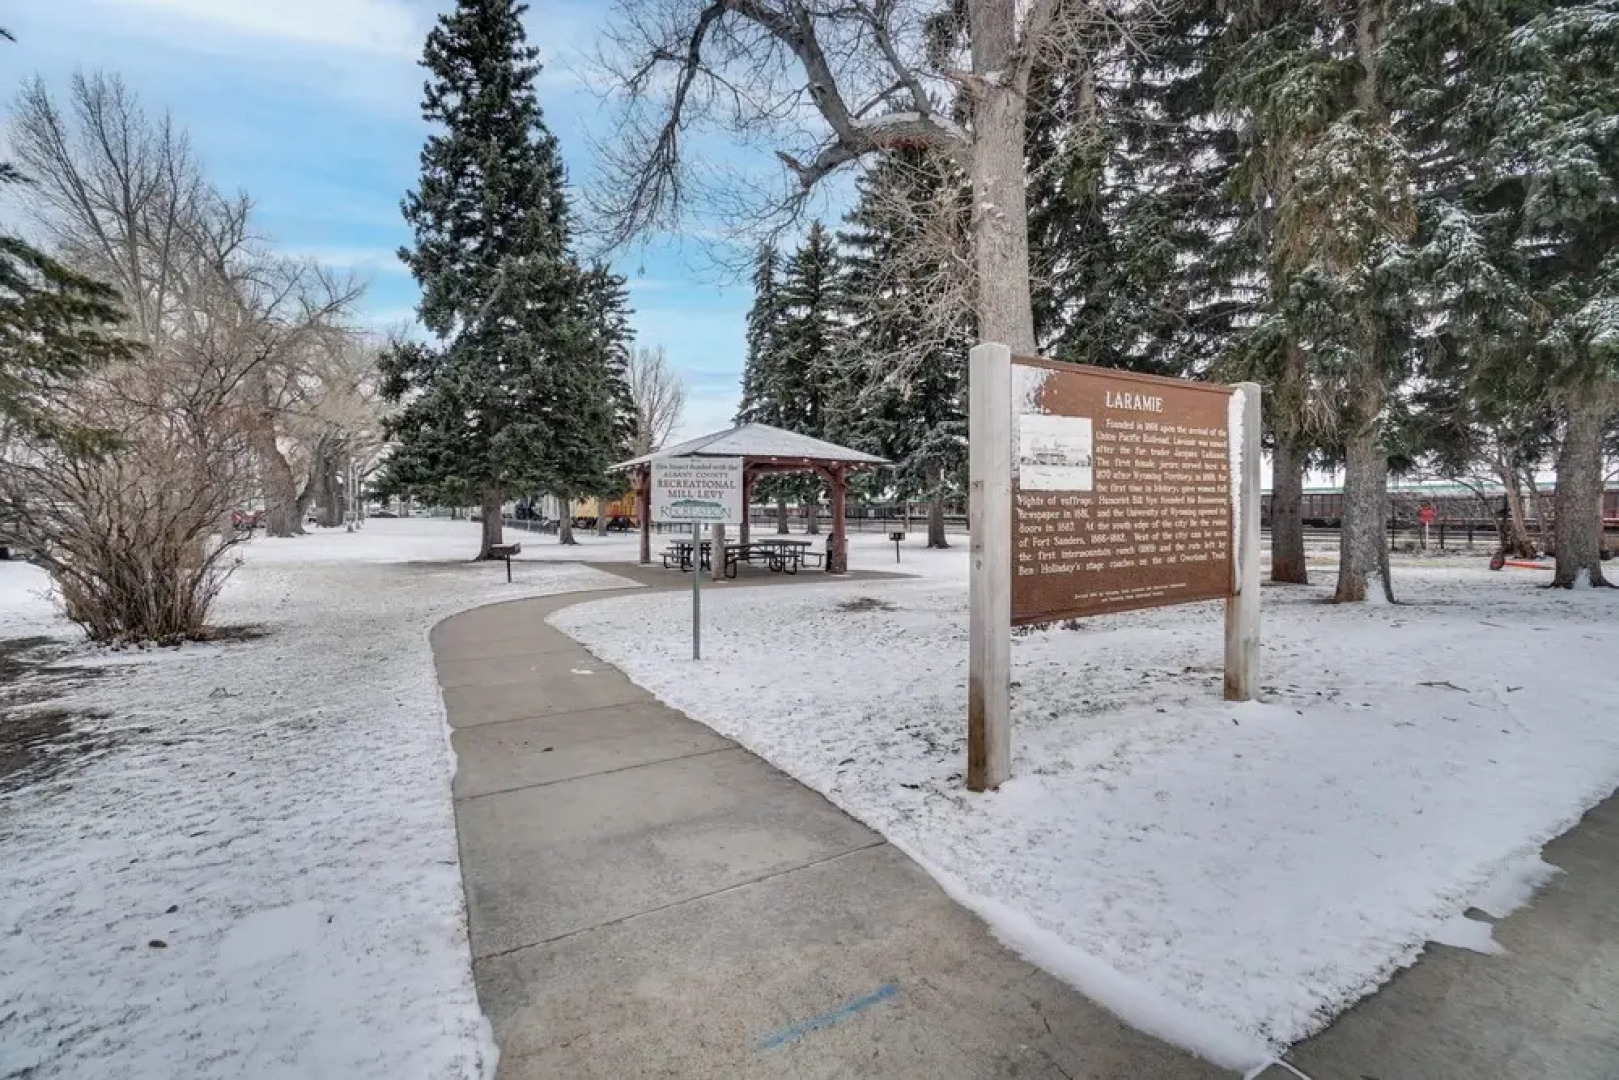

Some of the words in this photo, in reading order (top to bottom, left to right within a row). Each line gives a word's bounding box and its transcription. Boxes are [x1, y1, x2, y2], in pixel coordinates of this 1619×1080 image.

[1106, 391, 1164, 413] LARAMIE
[1106, 419, 1135, 429] Founded
[1136, 421, 1143, 430] in
[1160, 424, 1175, 435] upon
[1177, 425, 1186, 433] the
[1209, 428, 1216, 436] of
[1218, 429, 1227, 437] the
[1095, 431, 1116, 440] Union
[1118, 432, 1140, 442] Pacific
[1096, 445, 1114, 453] after
[1151, 447, 1170, 456] trader
[1096, 457, 1109, 466] The
[1115, 458, 1130, 467] first
[1112, 471, 1131, 479] after
[1132, 471, 1161, 481] Wyoming
[657, 480, 736, 489] RECREATIONAL
[1096, 484, 1109, 492] the
[1111, 484, 1126, 492] first
[668, 490, 693, 498] MILL
[697, 489, 725, 499] LEVY
[1047, 496, 1056, 505] of
[1063, 510, 1071, 518] in
[1097, 508, 1110, 517] and
[1113, 508, 1124, 517] the
[1126, 507, 1159, 518] University
[1161, 508, 1167, 516] of
[1170, 507, 1197, 517] Wyoming
[1018, 522, 1042, 533] doors
[1045, 522, 1054, 532] in
[1085, 522, 1094, 531] At
[1097, 521, 1110, 530] the
[1151, 520, 1159, 529] of
[1161, 519, 1172, 528] the
[1174, 519, 1188, 529] city
[1200, 518, 1210, 527] the
[1018, 537, 1028, 547] of
[1032, 536, 1050, 547] Fort
[1151, 532, 1159, 540] of
[1162, 531, 1172, 540] the
[1174, 531, 1188, 540] city
[1203, 530, 1211, 538] be
[1018, 551, 1033, 561] the
[1038, 550, 1057, 561] first
[1160, 543, 1171, 552] and
[1174, 541, 1185, 551] the
[1018, 564, 1034, 576] Ben
[1040, 561, 1080, 574] Holladay's
[1152, 556, 1162, 565] the
[1180, 553, 1207, 562] Overland
